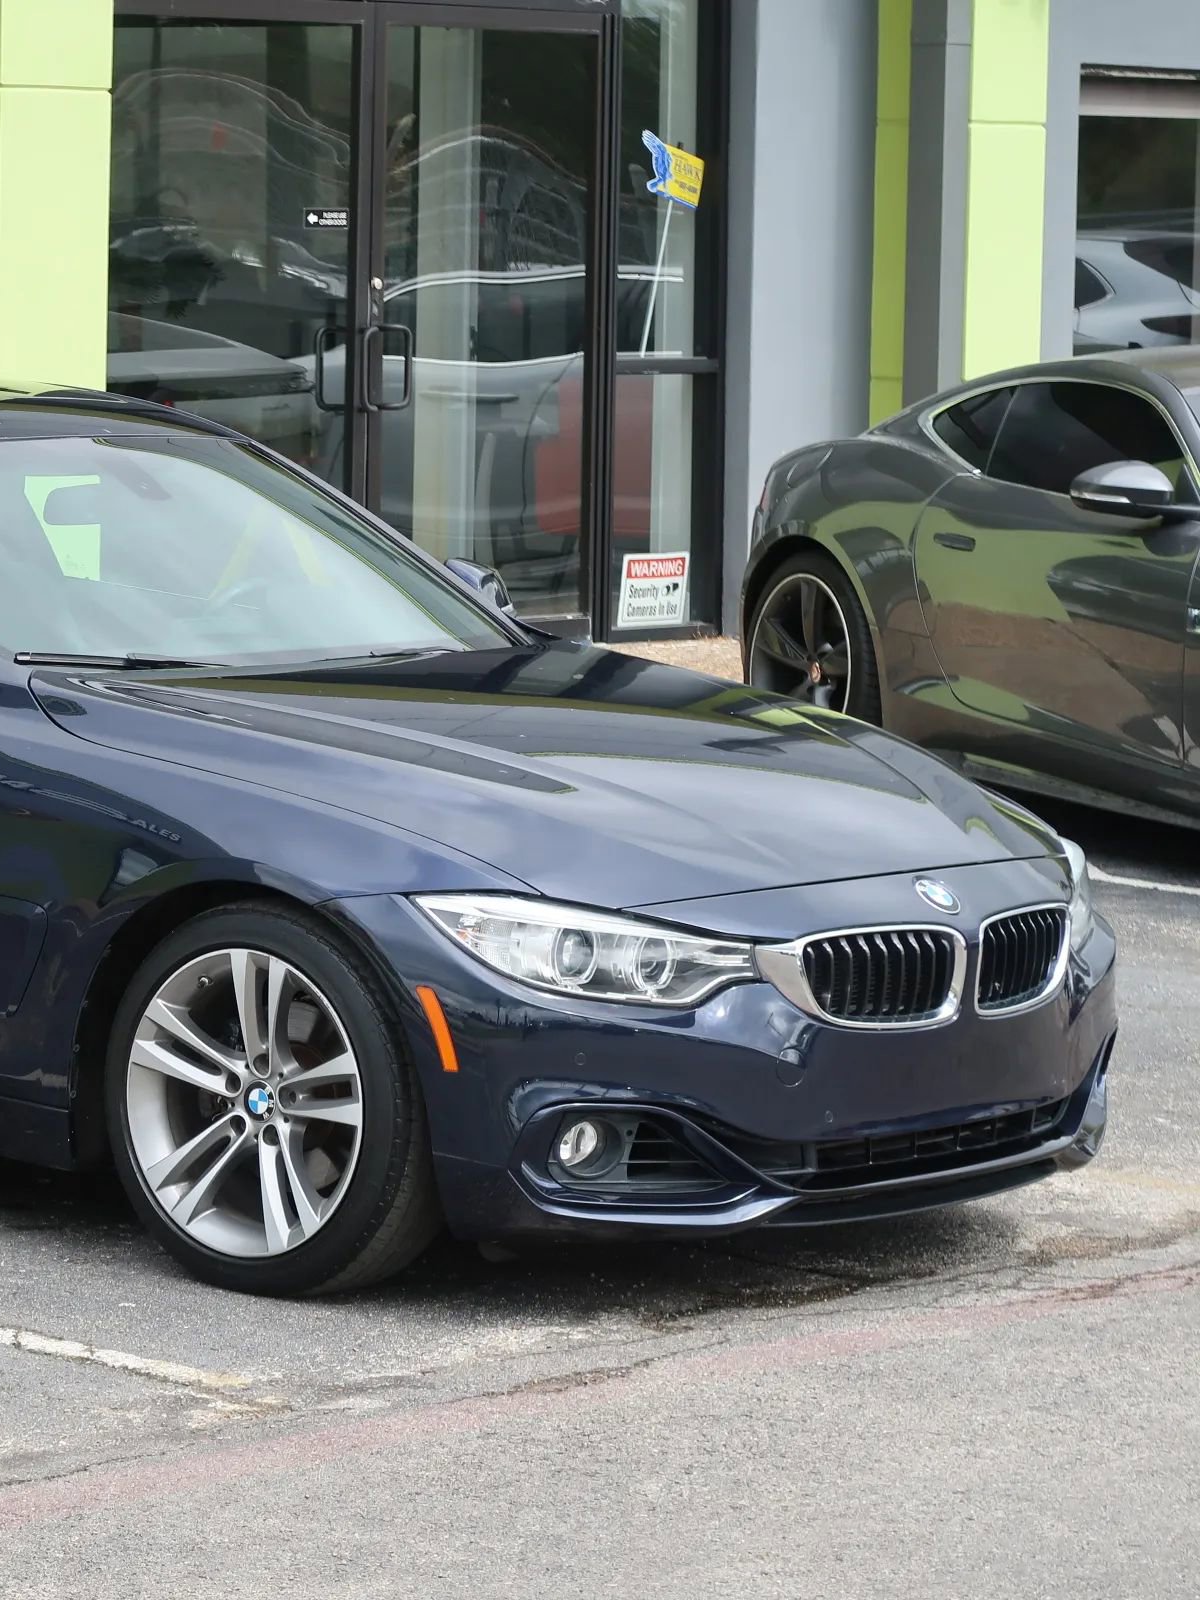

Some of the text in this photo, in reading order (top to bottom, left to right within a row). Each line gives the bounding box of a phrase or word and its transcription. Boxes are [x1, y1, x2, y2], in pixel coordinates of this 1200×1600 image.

[630, 559, 684, 577] WARNING
[628, 583, 659, 601] Security
[627, 602, 678, 617] Cameras In Use
